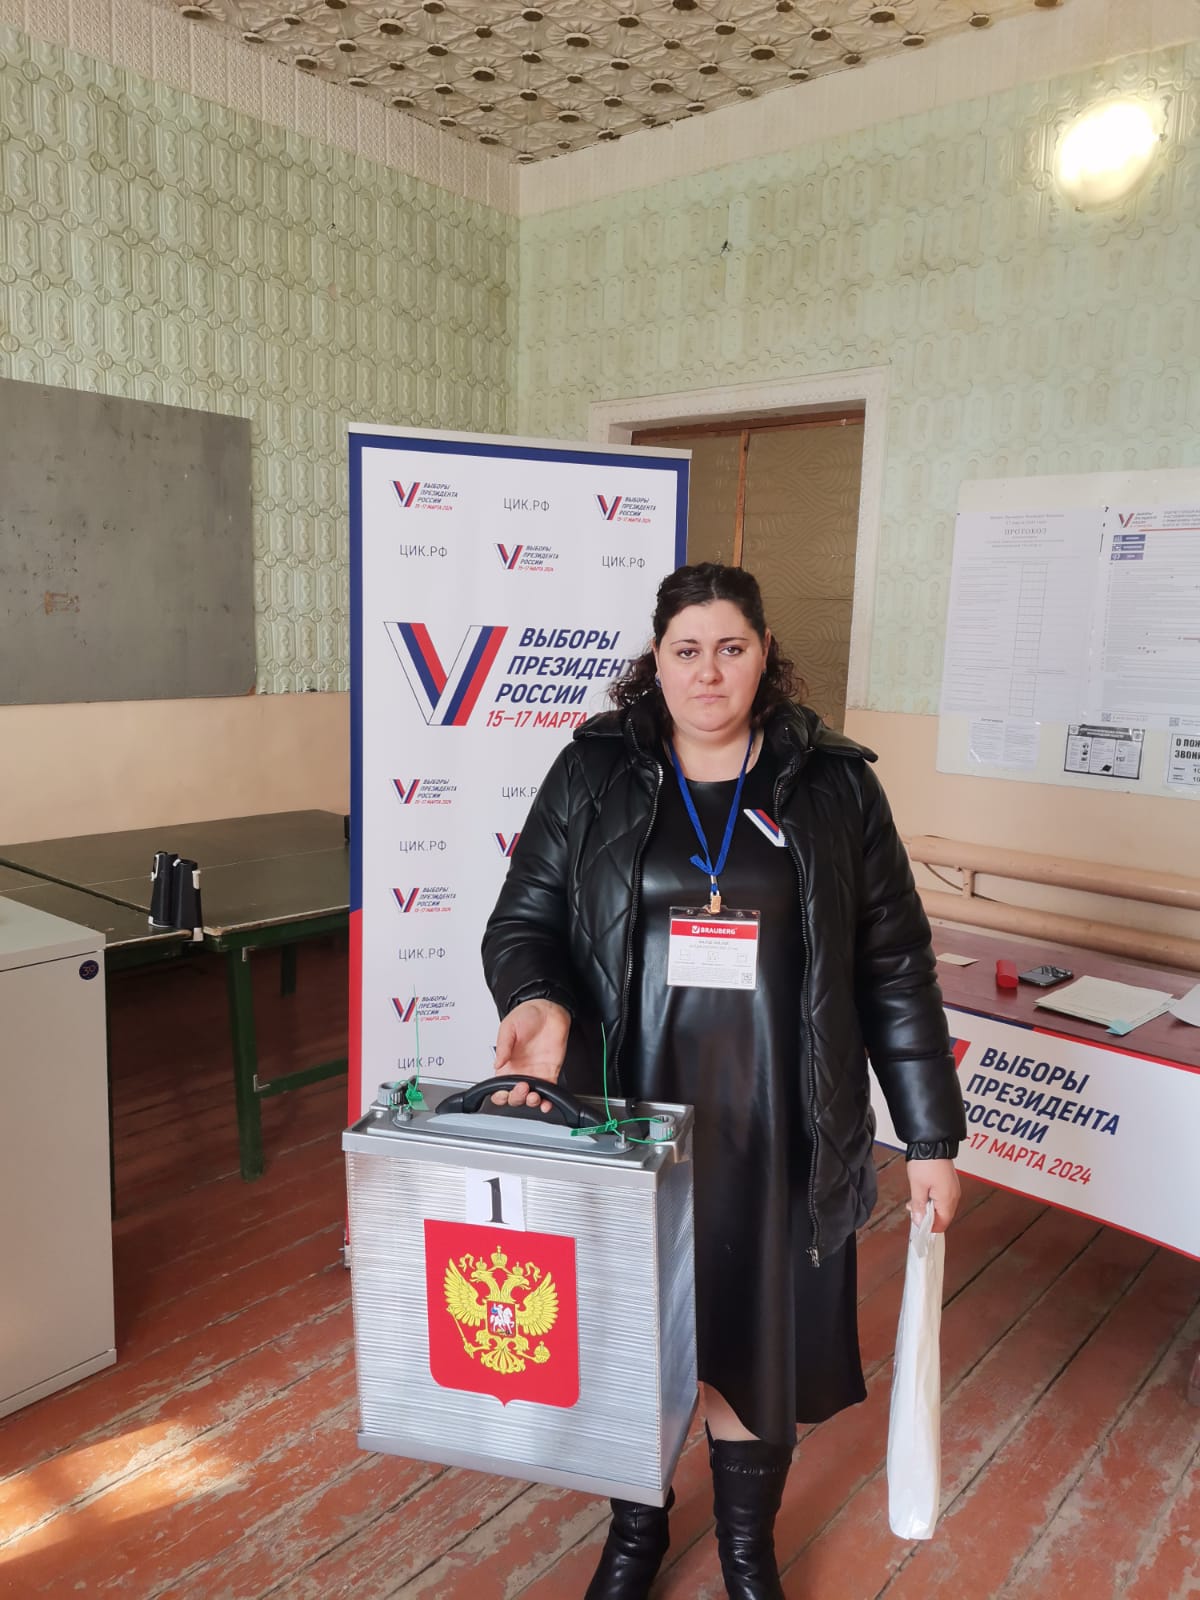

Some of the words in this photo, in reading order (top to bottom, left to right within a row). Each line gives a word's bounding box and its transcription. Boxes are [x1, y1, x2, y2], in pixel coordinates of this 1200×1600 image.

[423, 482, 450, 490] ВЫБОРЫ
[420, 489, 458, 498] ПРЕЗИДЕНТА
[503, 498, 550, 511] ЦИК.РФ
[399, 544, 448, 558] ЦИК.РФ
[602, 555, 646, 568] ЦИК.РФ
[519, 627, 620, 650] ВЫБОРЫ
[495, 683, 588, 704] РОССИИ
[502, 786, 537, 800] ЦИК.Р
[399, 840, 447, 853] ЦИК.РФ
[700, 927, 736, 935] BRAUBERG
[398, 947, 446, 961] ЦИК.РФ
[397, 1056, 445, 1070] ЦИК.РФ
[980, 1047, 1090, 1094] ВЫБОРЫ
[966, 1073, 1120, 1135] ПРЕЗИДЕНТА
[988, 1138, 1046, 1171] МАРТА
[1047, 1157, 1092, 1185] 2024
[483, 1176, 510, 1225] 1
